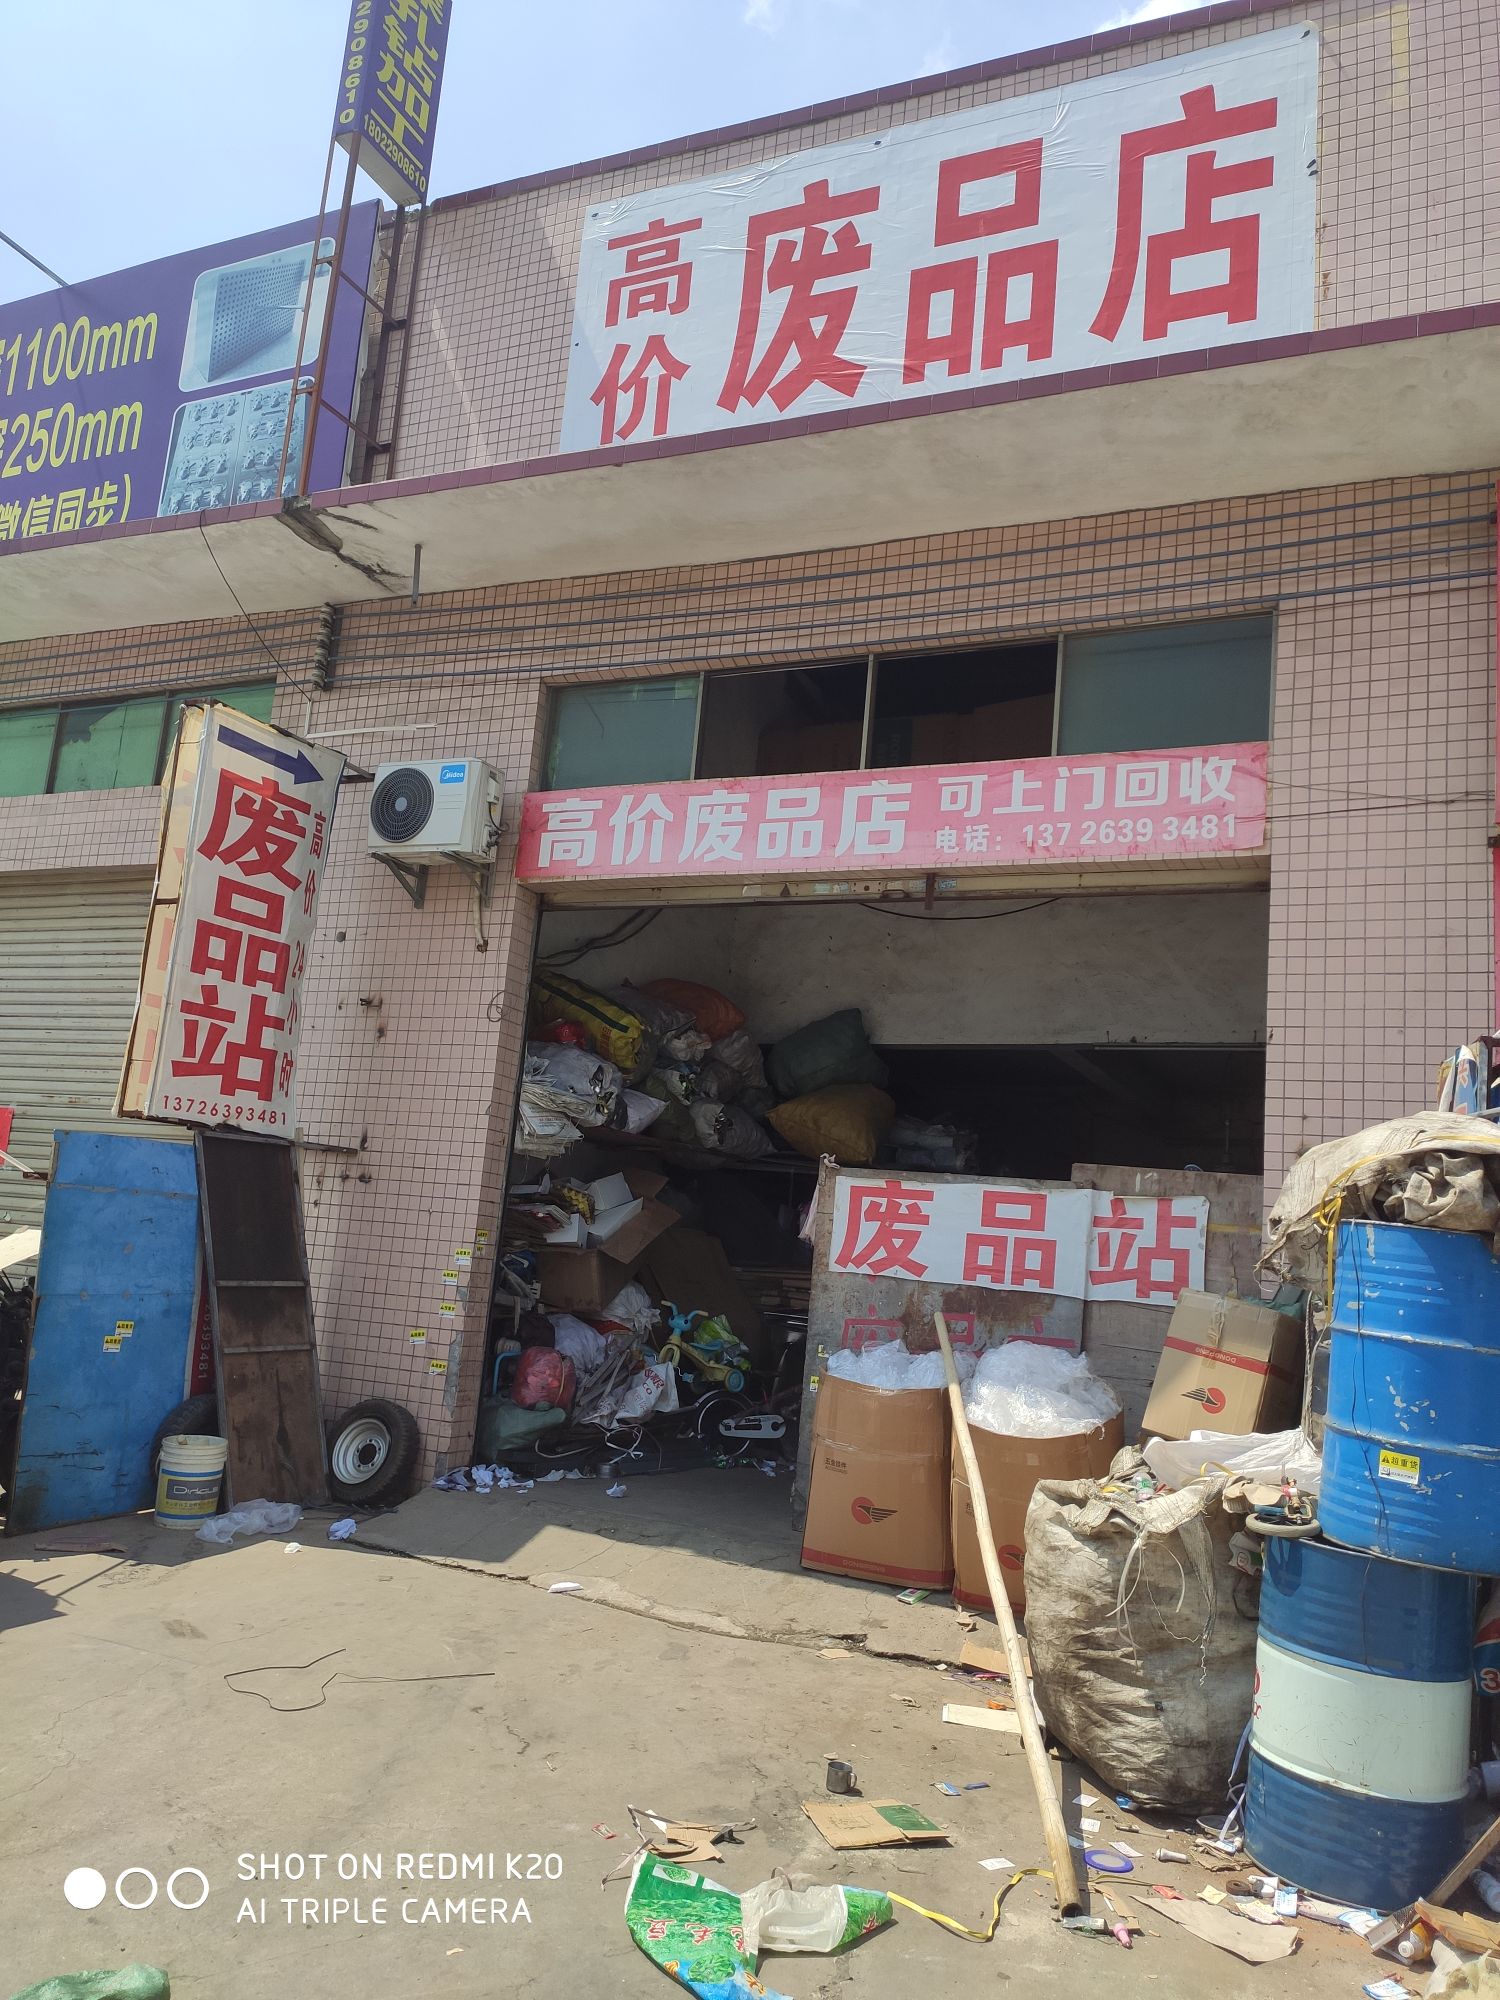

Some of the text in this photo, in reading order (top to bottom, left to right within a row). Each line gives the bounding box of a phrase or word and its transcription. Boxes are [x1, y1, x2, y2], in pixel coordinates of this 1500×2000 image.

[371, 0, 443, 170] 孔钻加工
[363, 114, 427, 193] 18022908610
[715, 83, 1278, 415] 废品店
[0, 312, 158, 396] 1100mm
[590, 216, 702, 446] 高价
[0, 401, 143, 479] 250mm
[537, 779, 913, 868] 高价废品店
[938, 755, 1238, 818] 可上门回收
[171, 767, 312, 1103] 废品站
[162, 1095, 287, 1126] 13726393481
[834, 1179, 1198, 1301] 废品站
